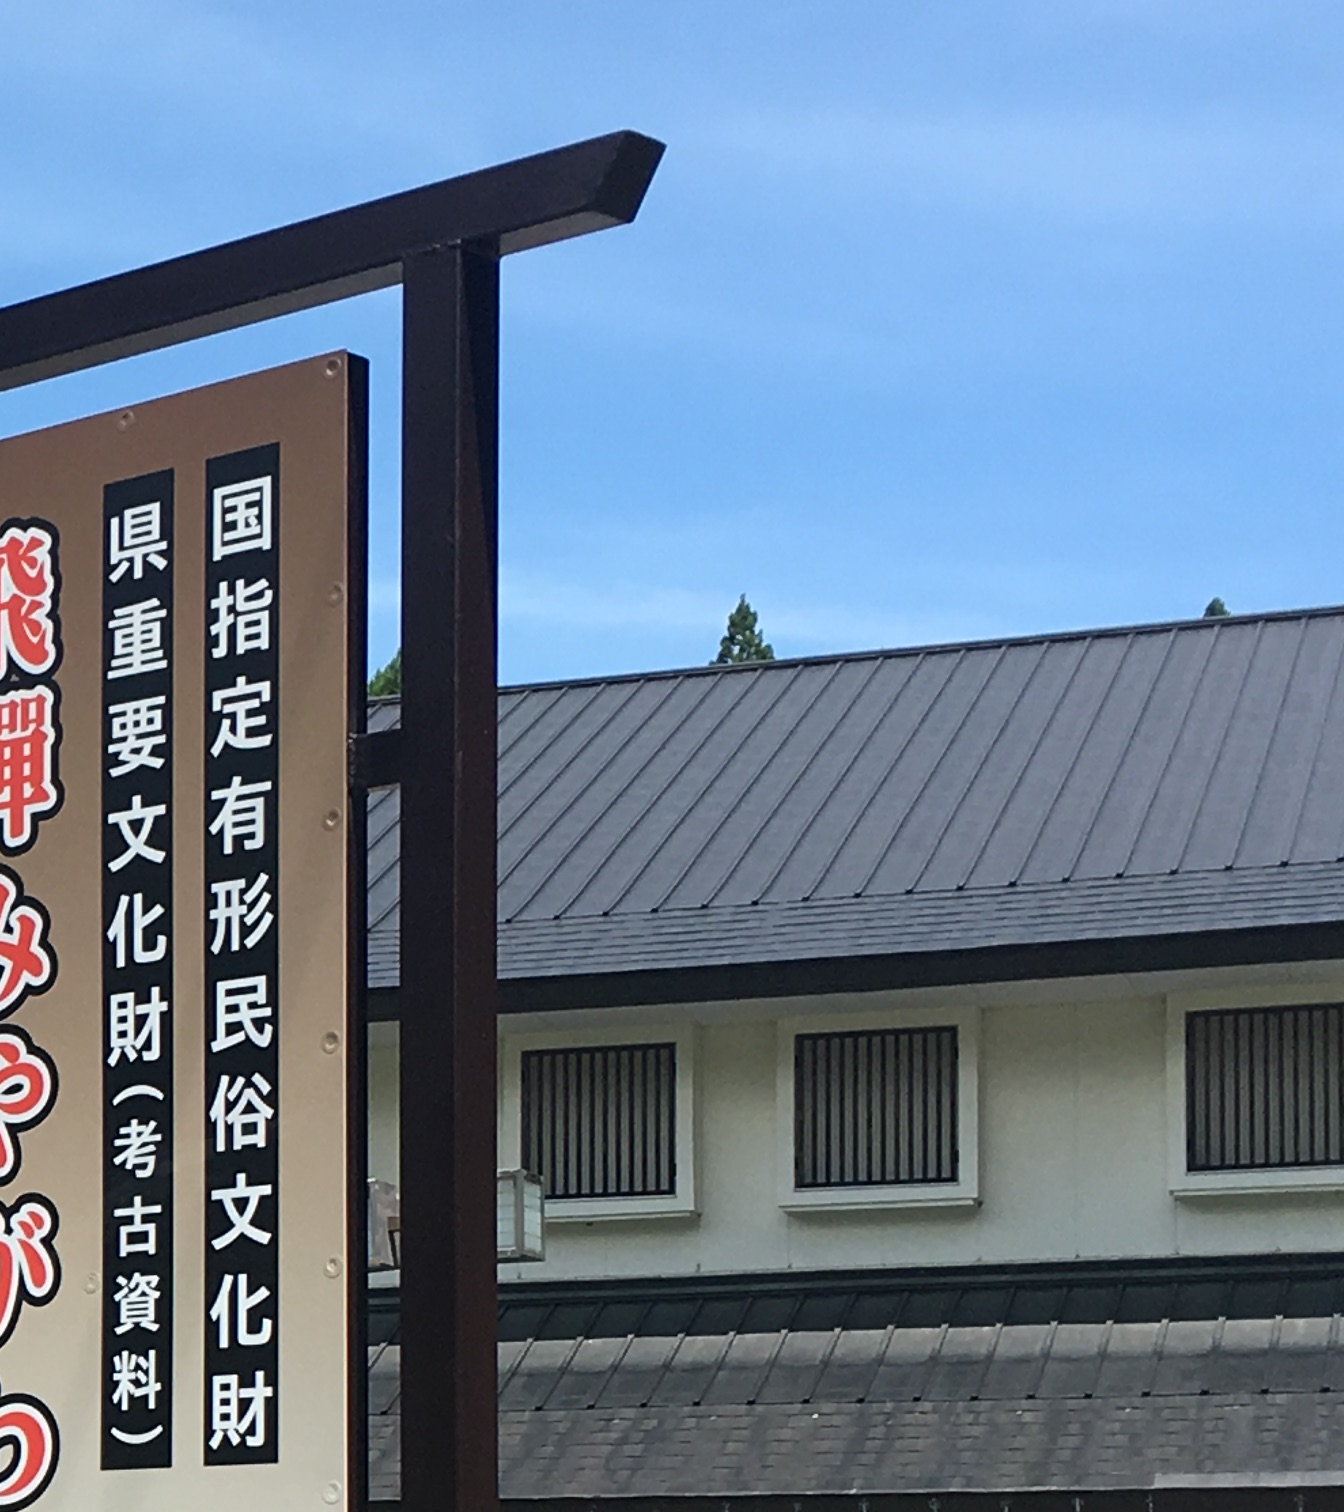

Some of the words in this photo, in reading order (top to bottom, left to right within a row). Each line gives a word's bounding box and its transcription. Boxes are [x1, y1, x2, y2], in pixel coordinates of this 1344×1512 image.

[209, 474, 275, 1450] 国指定有形民俗文化財
